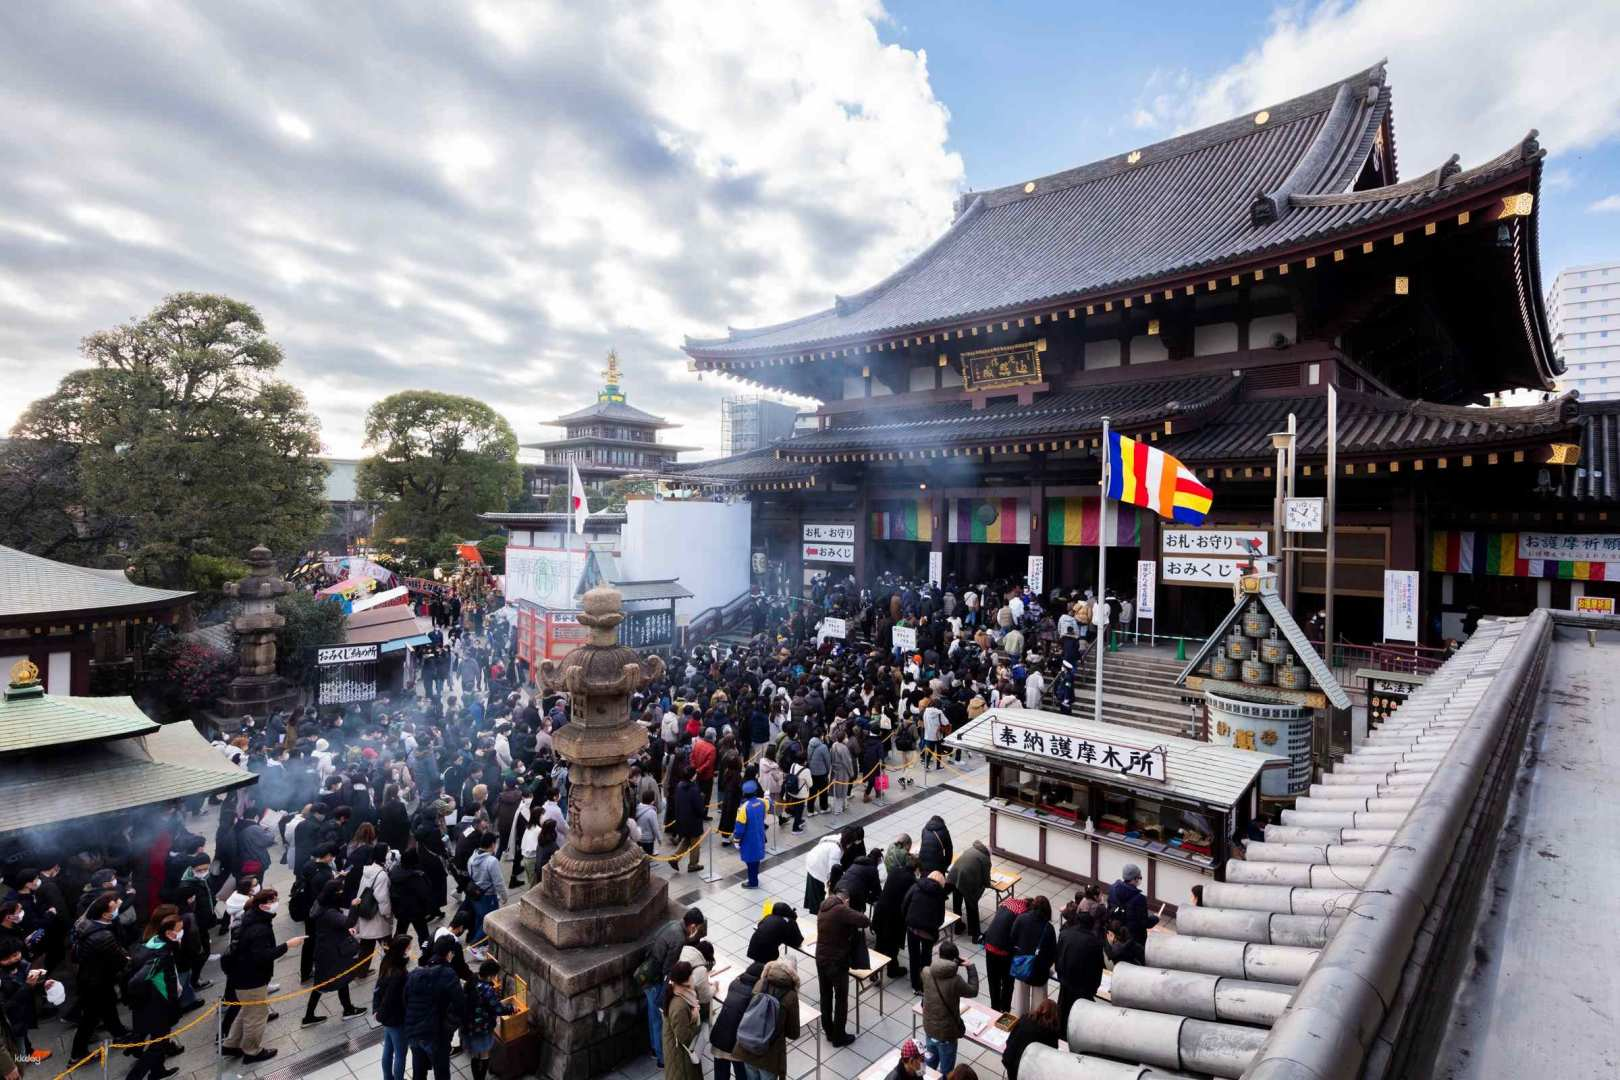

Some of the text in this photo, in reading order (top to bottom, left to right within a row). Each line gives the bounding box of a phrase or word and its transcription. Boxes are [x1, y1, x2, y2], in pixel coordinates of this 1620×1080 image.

[805, 527, 853, 539] お札・お守り
[1166, 534, 1233, 550] お札・お守り
[819, 547, 852, 558] おみくじ
[1168, 561, 1232, 578] おみくじ
[999, 725, 1154, 776] 奉納護摩木所
